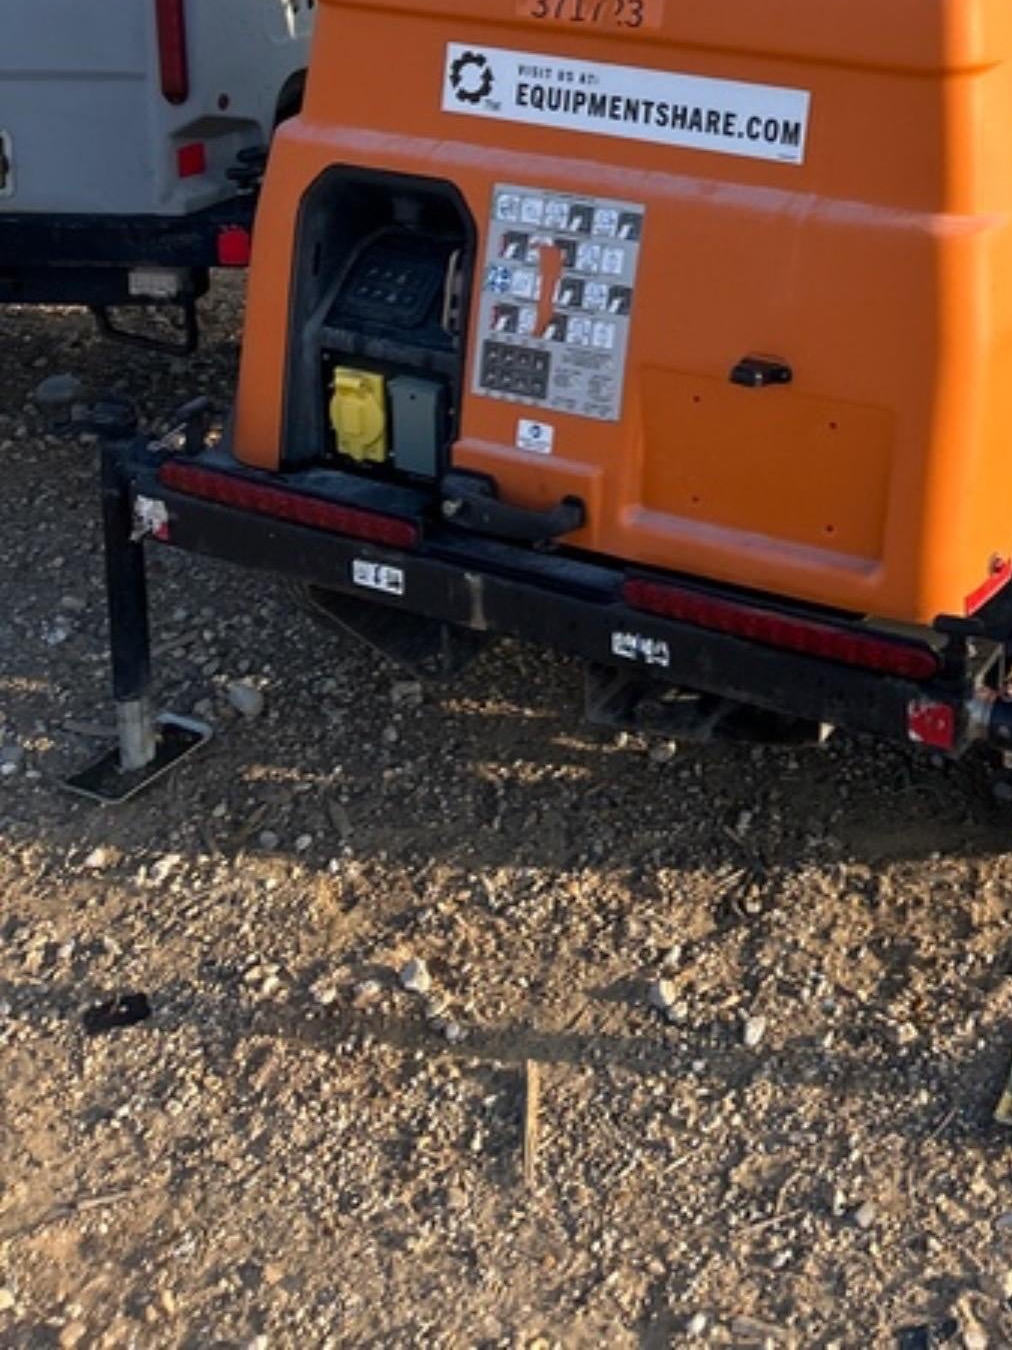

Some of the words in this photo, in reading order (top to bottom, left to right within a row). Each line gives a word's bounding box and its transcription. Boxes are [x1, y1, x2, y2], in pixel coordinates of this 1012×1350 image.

[517, 63, 552, 79] VISIT
[557, 68, 574, 82] US
[514, 82, 802, 148] EQUIPMENTSHARE.COM
